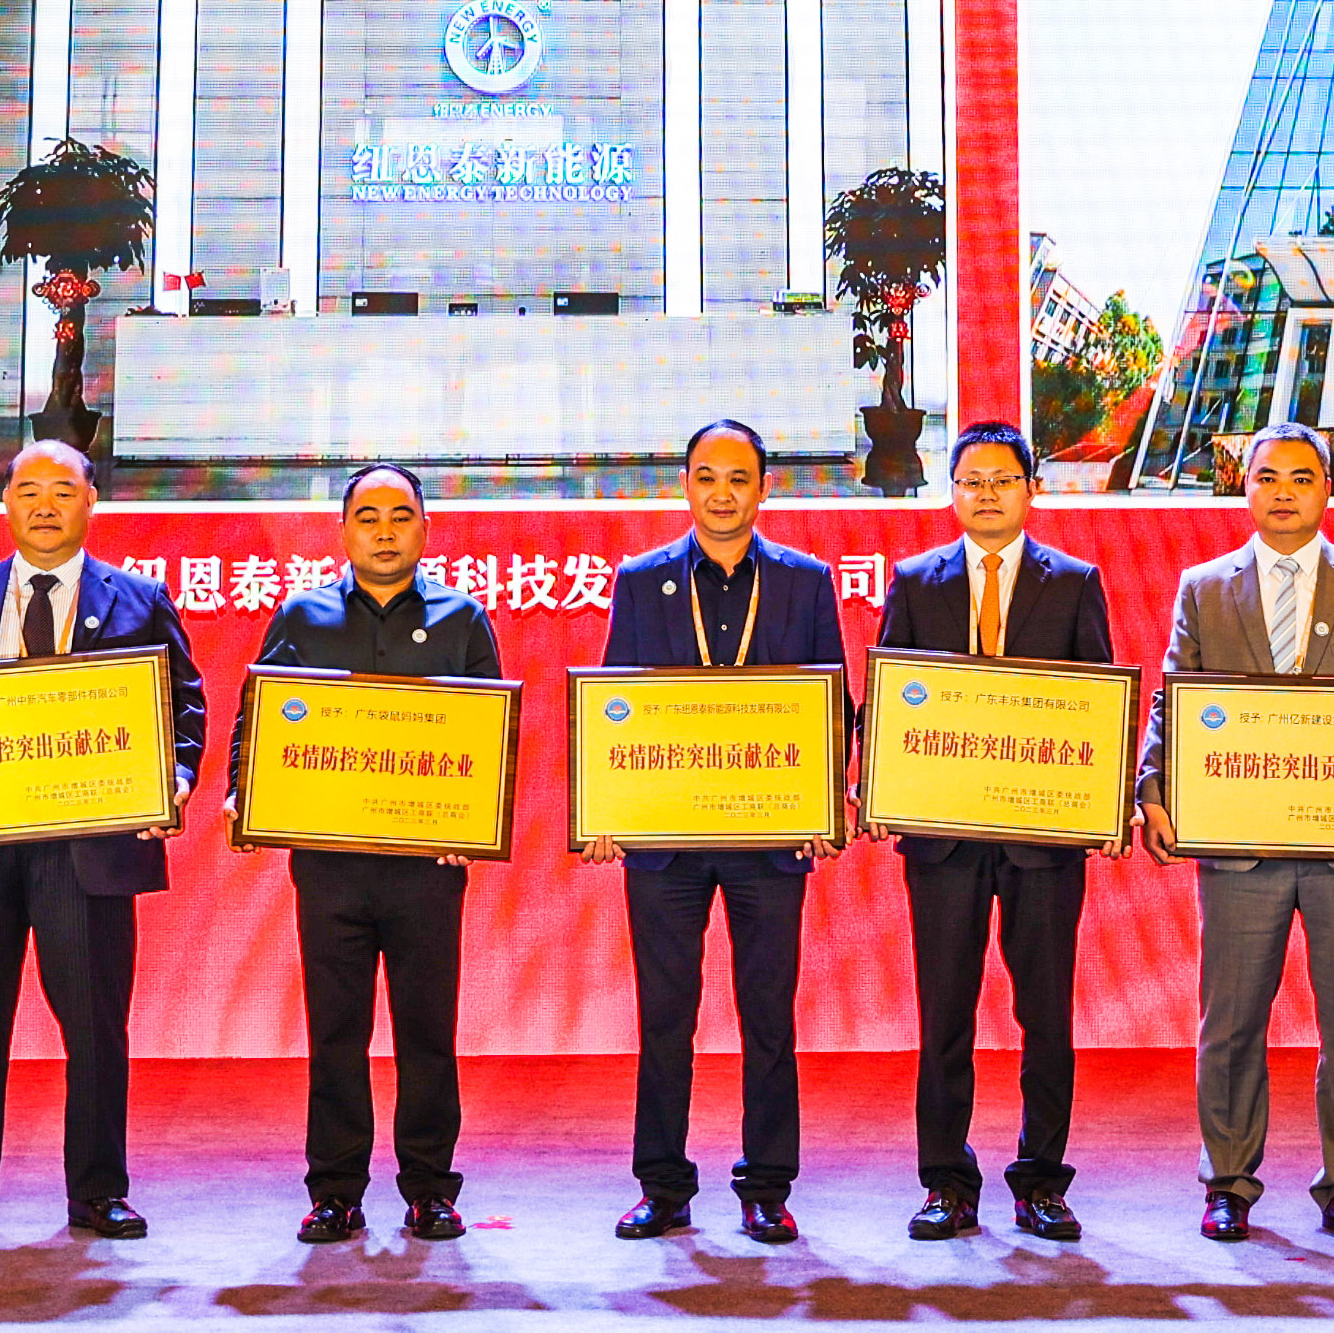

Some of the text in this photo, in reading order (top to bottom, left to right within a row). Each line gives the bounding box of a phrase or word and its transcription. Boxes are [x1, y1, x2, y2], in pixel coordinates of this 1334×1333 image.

[352, 142, 635, 184] 纽恩泰新能源
[352, 185, 634, 202] NEW ENERGY TECHNOLOGY
[282, 743, 474, 778] 疫情防控突出贡献企业
[609, 742, 801, 771] 疫情防控突出贡献企业
[903, 727, 1095, 767] 疫情防控突出贡献企业
